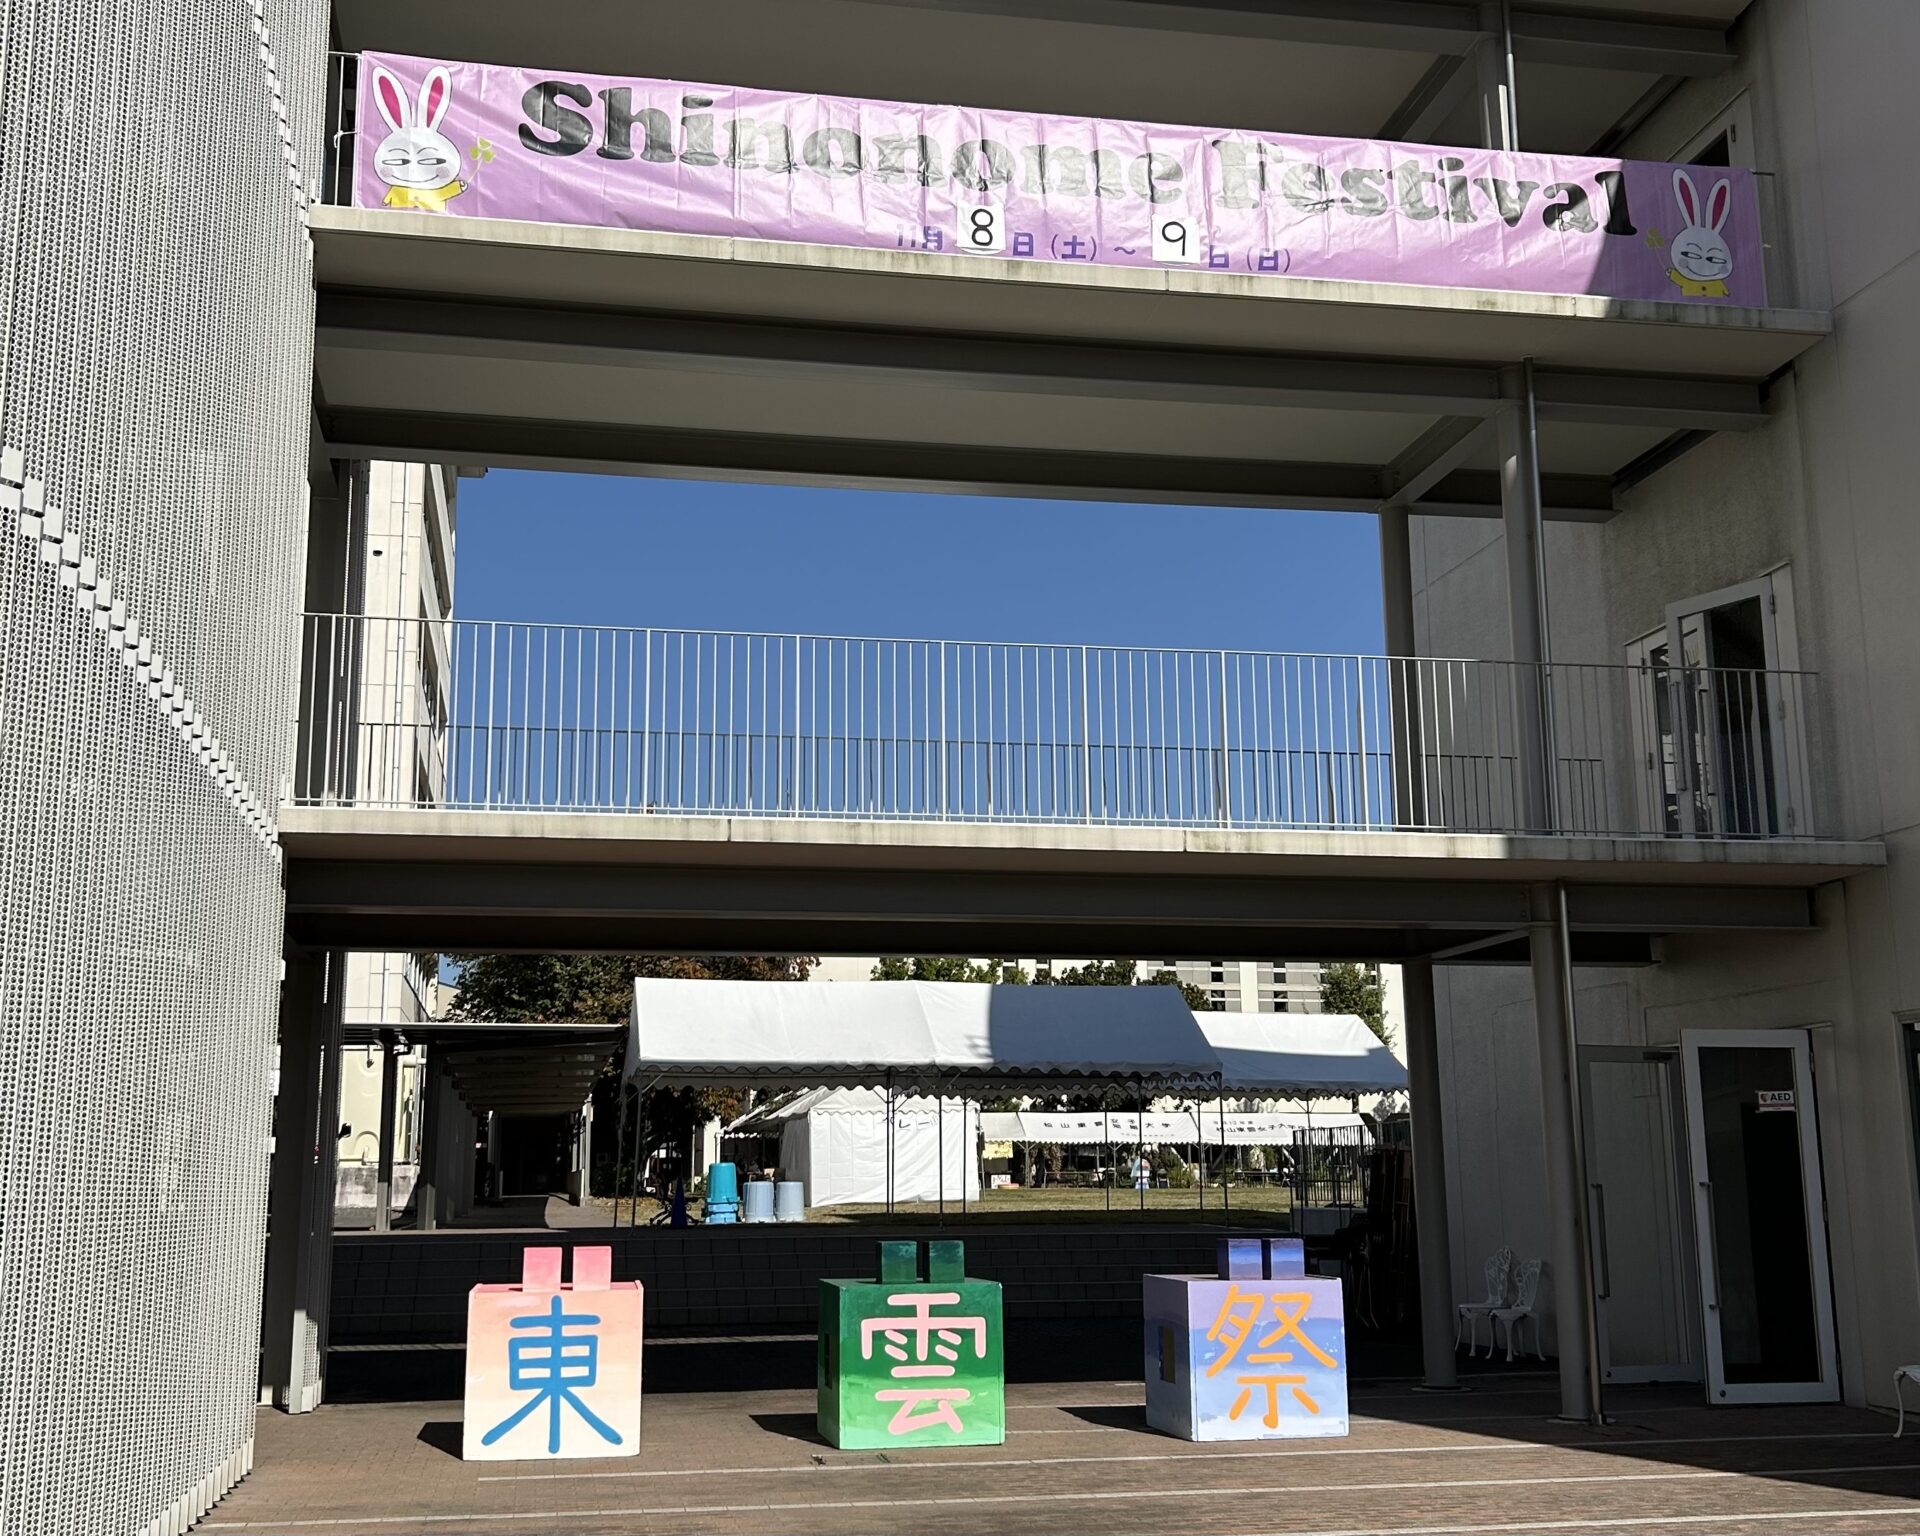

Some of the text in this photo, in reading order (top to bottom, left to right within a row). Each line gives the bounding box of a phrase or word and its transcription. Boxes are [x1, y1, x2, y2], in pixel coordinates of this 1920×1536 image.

[517, 80, 1638, 236] Shinonome Festival
[1770, 1092, 1791, 1101] AED
[481, 1295, 624, 1454] 東
[860, 1291, 988, 1436] 雲
[1206, 1284, 1338, 1430] 祭
